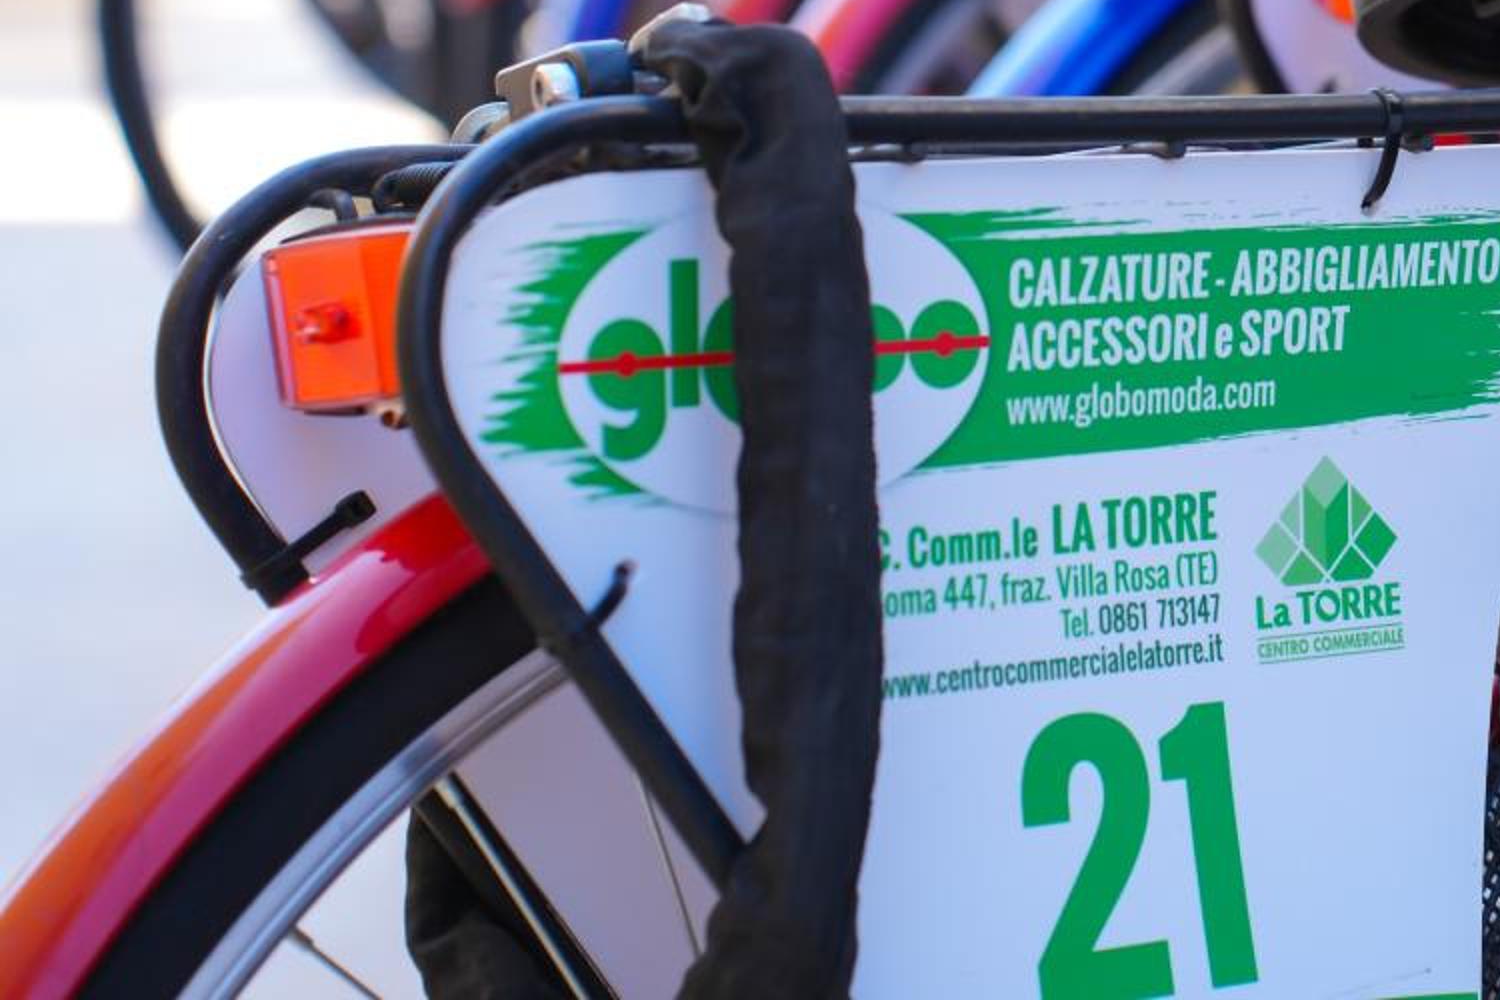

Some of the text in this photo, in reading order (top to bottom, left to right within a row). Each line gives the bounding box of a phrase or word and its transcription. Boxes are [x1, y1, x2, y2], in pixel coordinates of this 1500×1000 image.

[1008, 250, 1210, 308] CALZATURE
[1230, 237, 1500, 297] ABBIGLIAMENTO
[1006, 304, 1350, 372] ACCESSORI e SPORT
[1006, 377, 1277, 429] www.globomoda.com
[907, 517, 1038, 569] Comm.le
[1053, 501, 1095, 555] LA
[1101, 490, 1217, 549] TORRE
[883, 549, 1218, 618] oma 447, fraz. Villa Rosa (TE)
[1061, 592, 1220, 640] Tel. 0861 713147
[1255, 582, 1400, 630] La TORRE
[1257, 626, 1404, 658] CENTRO COMMERCIALE
[1020, 699, 1260, 1000] 21
